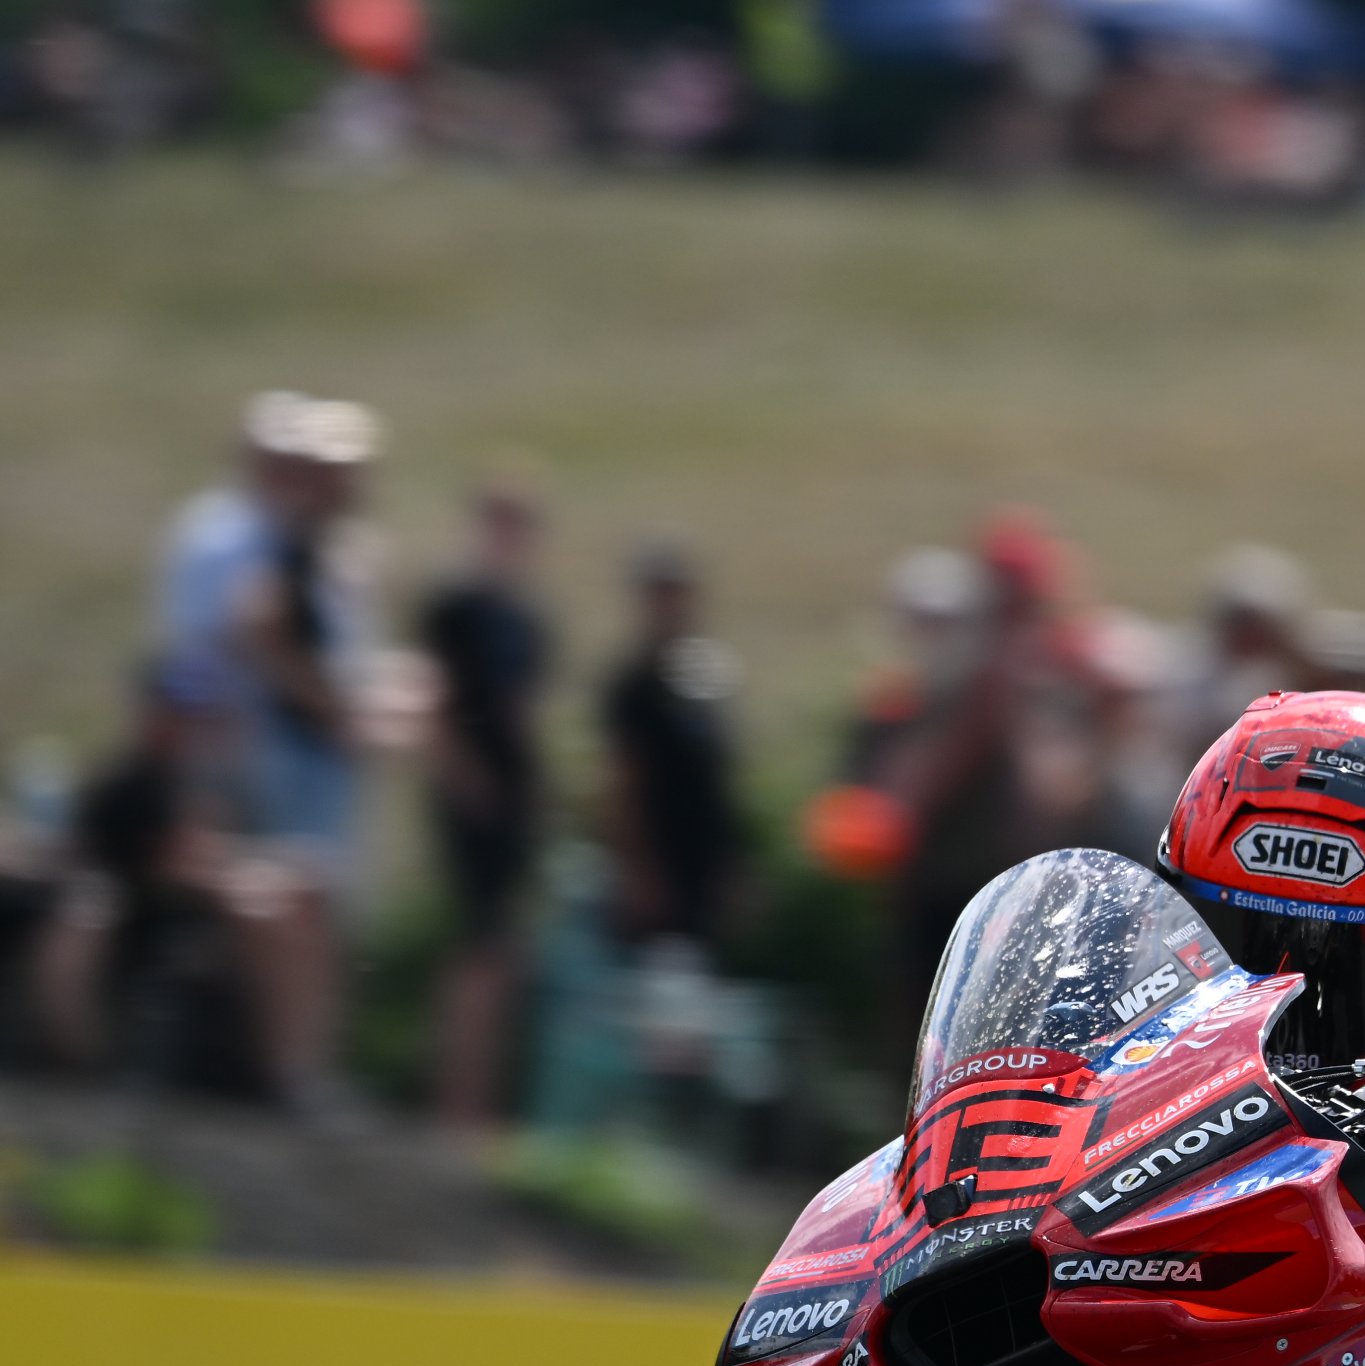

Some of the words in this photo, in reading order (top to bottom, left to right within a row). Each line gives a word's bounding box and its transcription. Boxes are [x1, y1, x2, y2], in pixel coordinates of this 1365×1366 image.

[1250, 834, 1350, 877] SHOEI
[1234, 891, 1284, 914] Estrella
[1286, 901, 1337, 921] Galicia
[1162, 920, 1202, 949] MARQUEZ
[1111, 962, 1180, 1024] WRS
[1266, 1051, 1320, 1069] ta360
[1085, 1058, 1257, 1165] FRECCIAROSSA
[1078, 1096, 1270, 1214] Lenovo
[768, 1246, 870, 1278] FRECCIAROSSA
[1053, 1259, 1204, 1283] CARRERA
[735, 1299, 850, 1347] Lenovo
